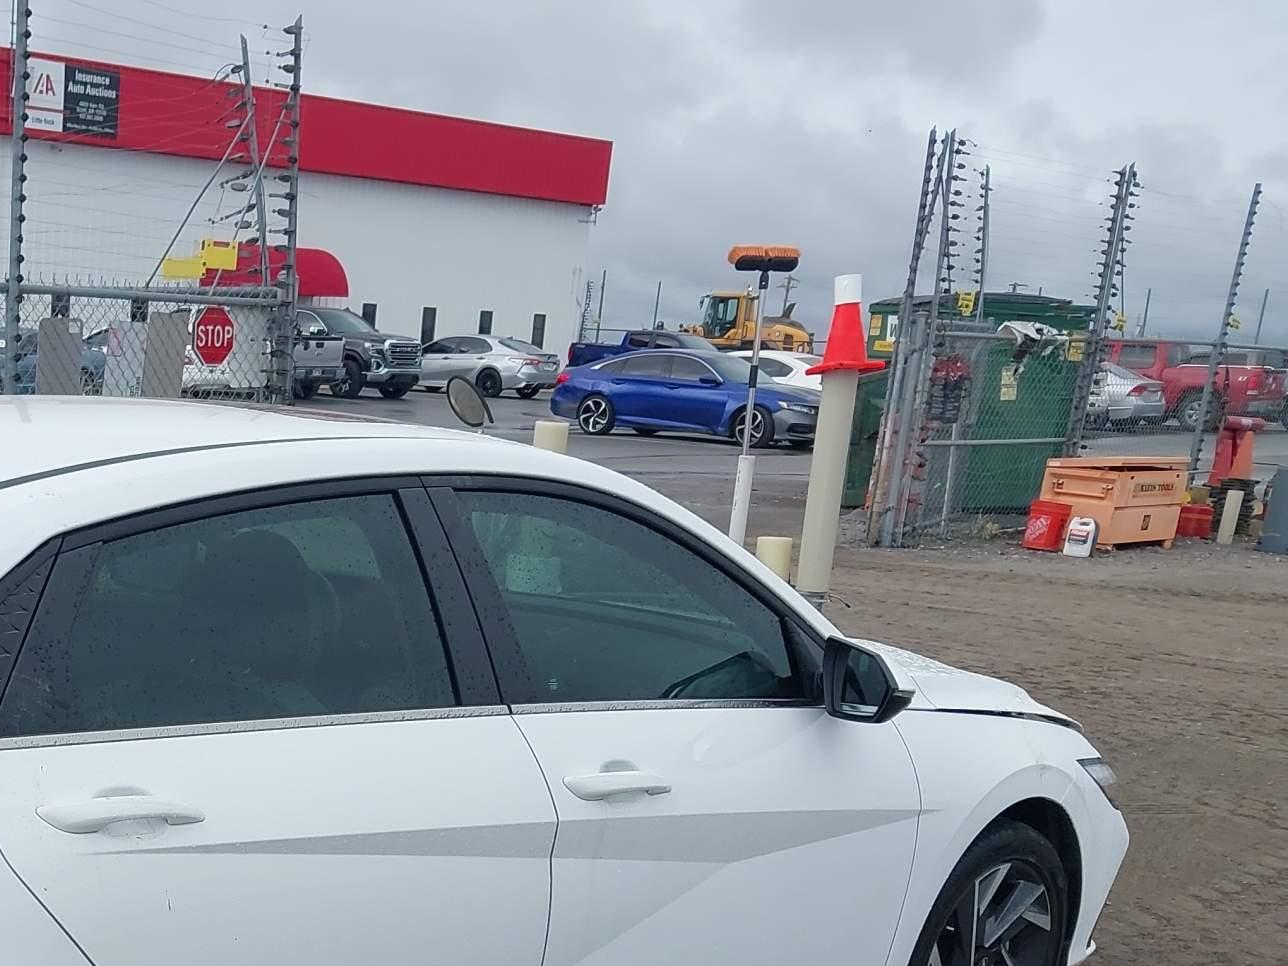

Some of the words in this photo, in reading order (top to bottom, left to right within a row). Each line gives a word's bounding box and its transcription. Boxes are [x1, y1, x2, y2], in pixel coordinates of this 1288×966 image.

[75, 69, 110, 85] Insurance
[67, 81, 85, 93] Auto
[86, 84, 116, 98] Auctions
[197, 325, 232, 348] STOP
[1140, 483, 1157, 492] KLEIN
